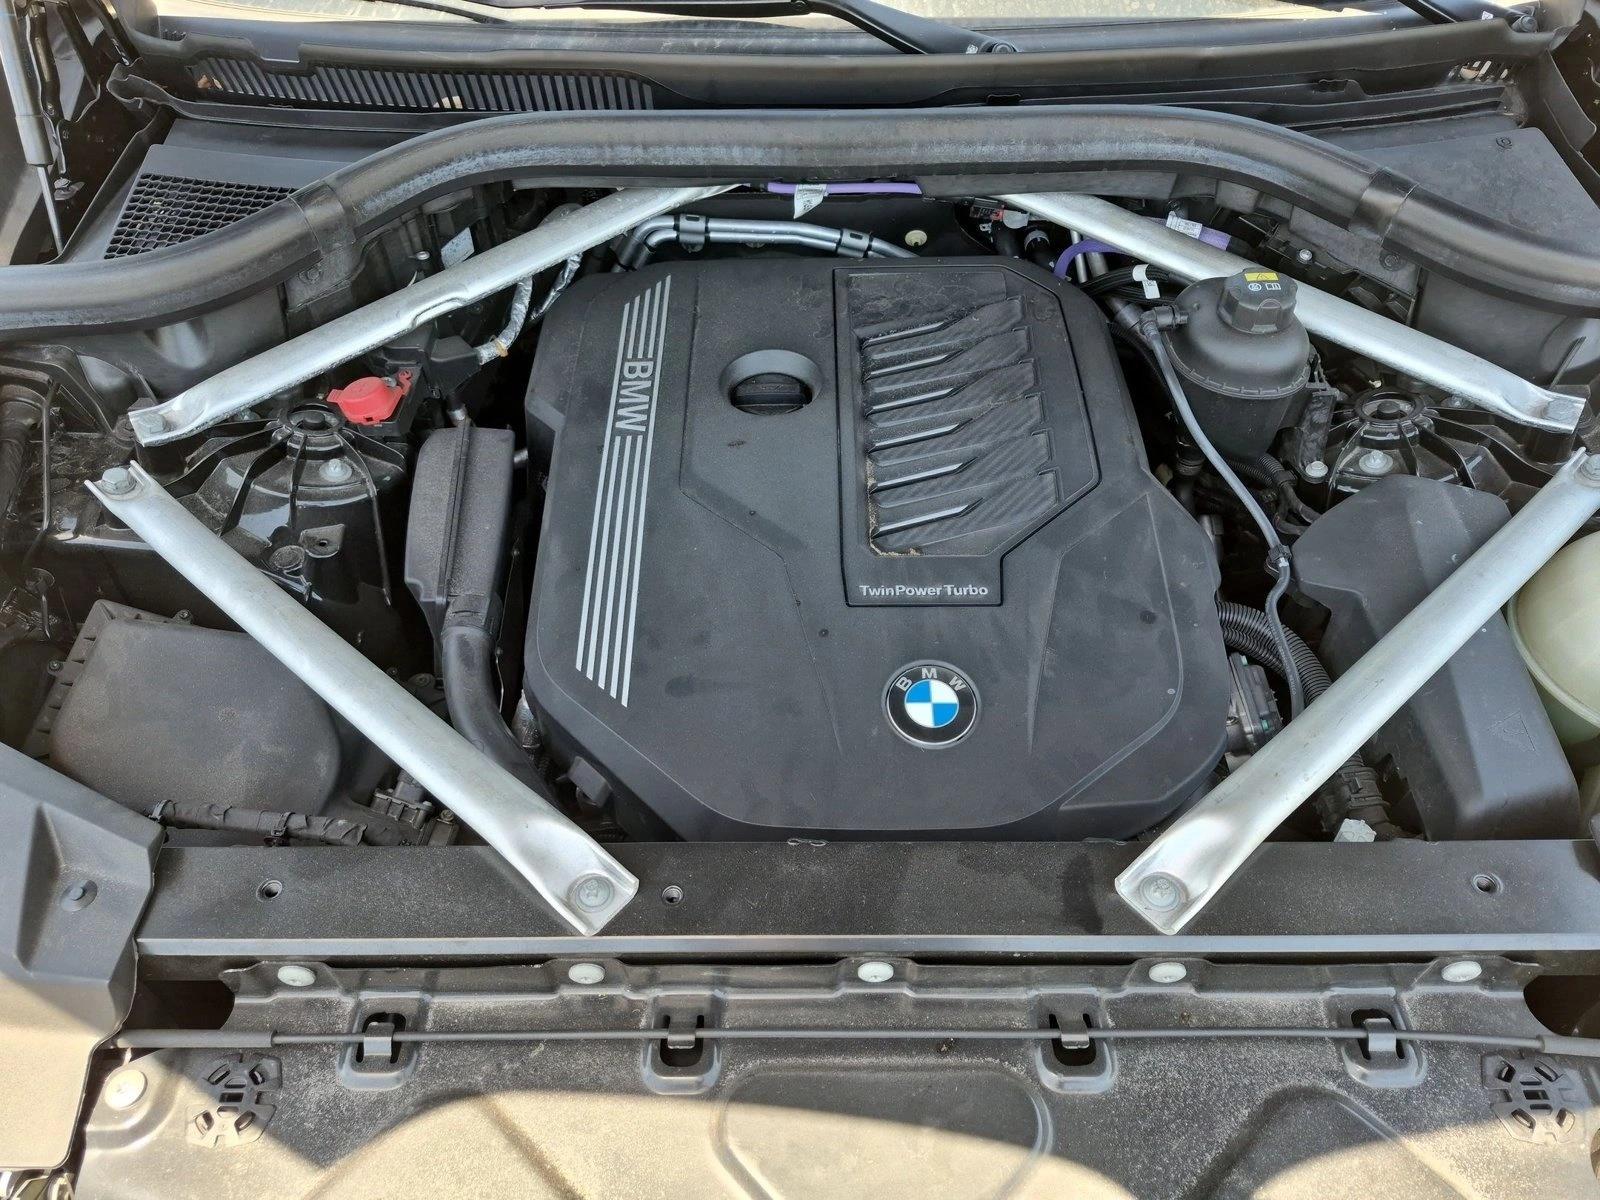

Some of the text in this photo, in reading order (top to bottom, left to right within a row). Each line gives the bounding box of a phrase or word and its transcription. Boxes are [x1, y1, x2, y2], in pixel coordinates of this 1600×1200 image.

[615, 361, 654, 432] BMW
[943, 583, 989, 596] Turbo
[895, 667, 967, 692] BMW
